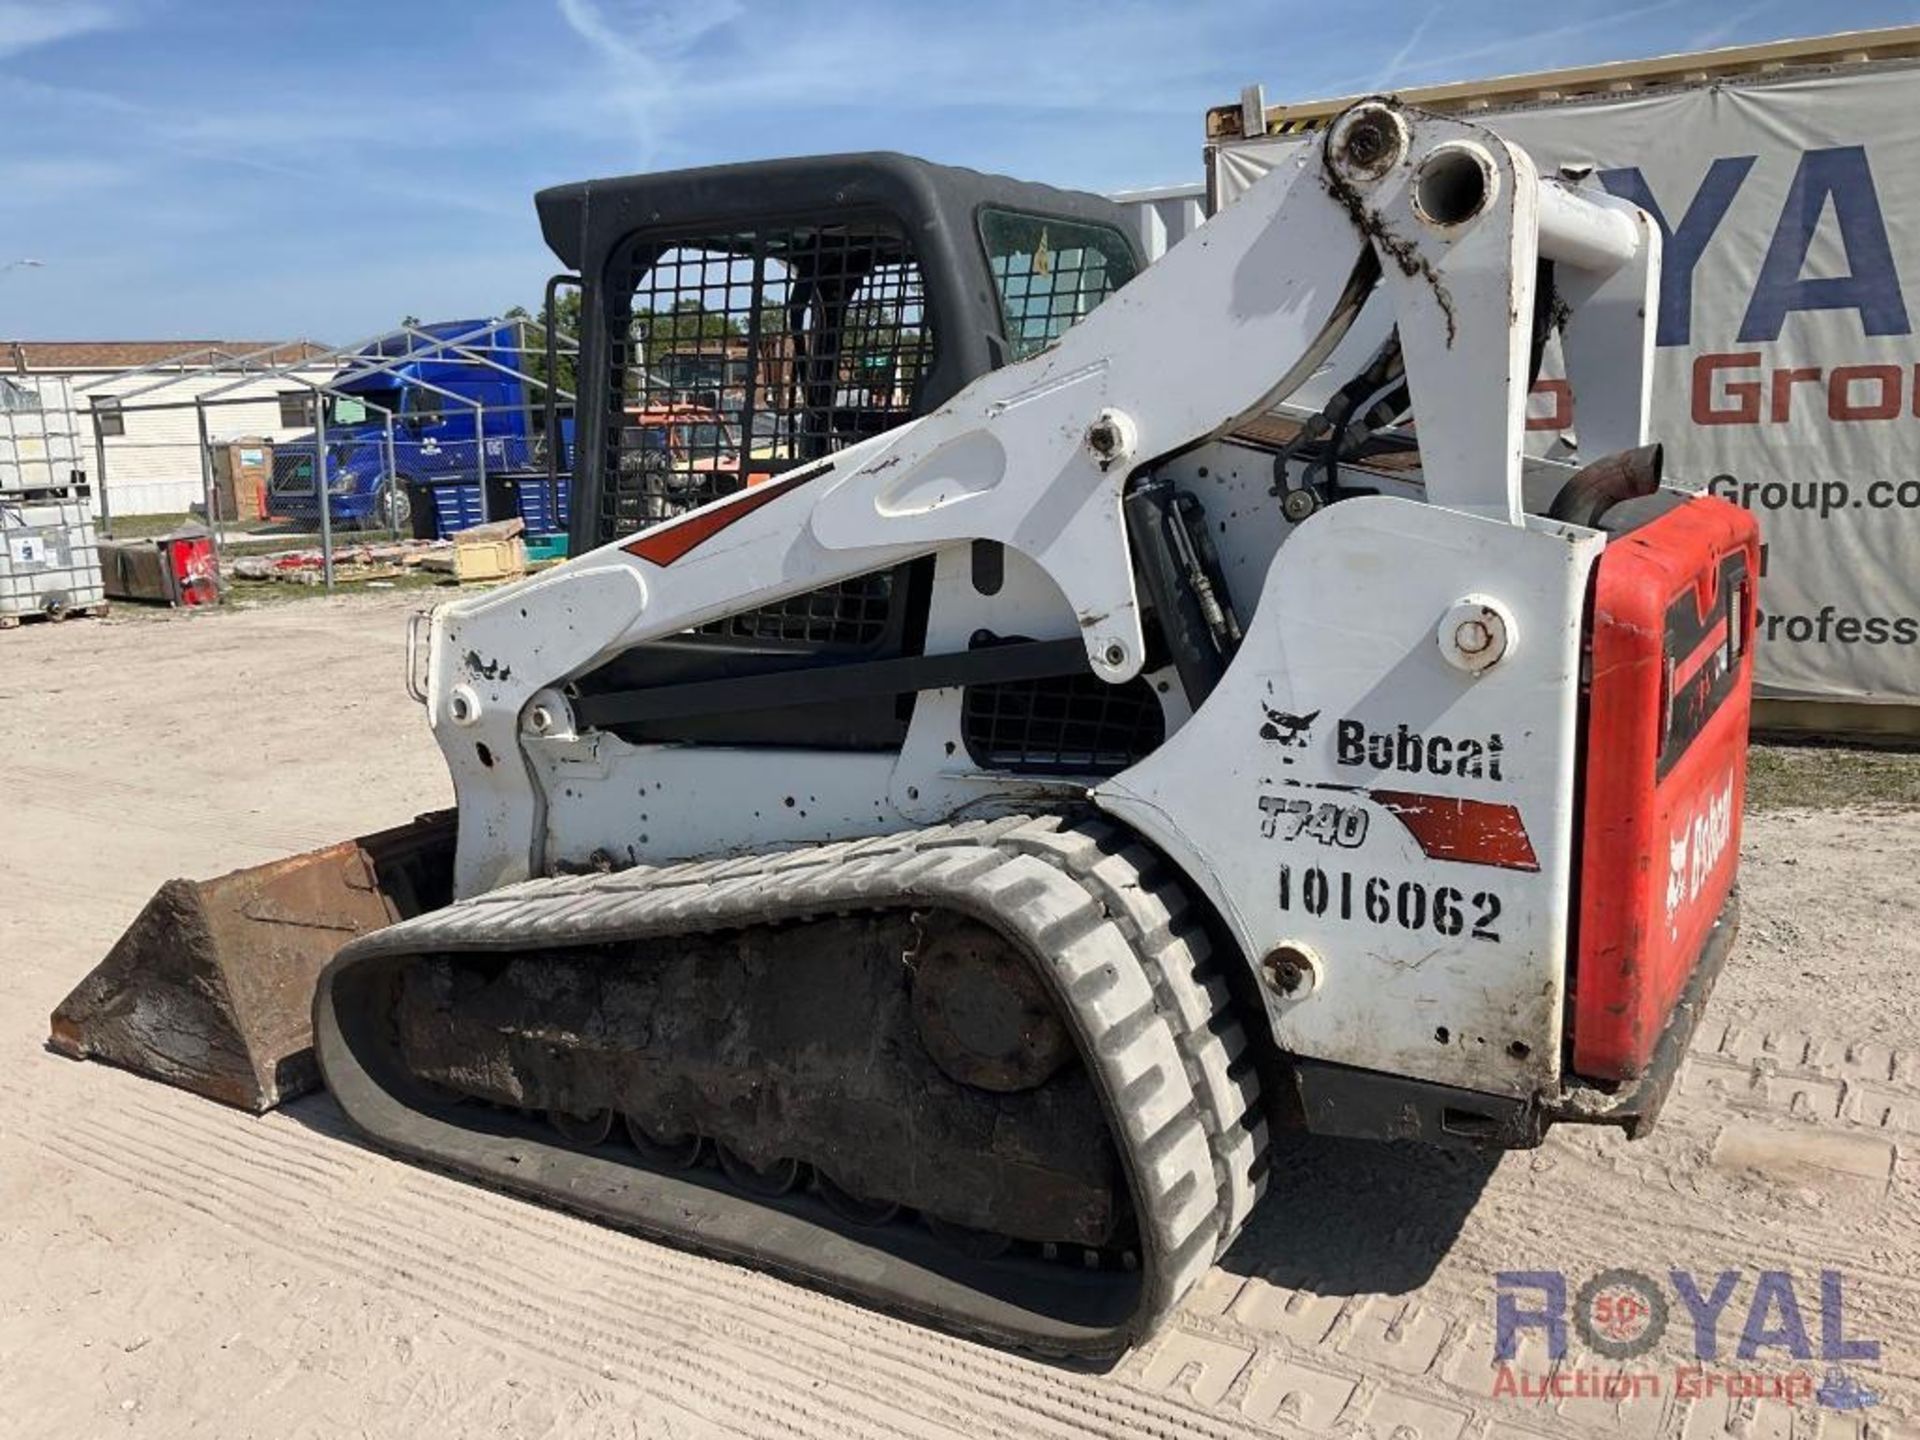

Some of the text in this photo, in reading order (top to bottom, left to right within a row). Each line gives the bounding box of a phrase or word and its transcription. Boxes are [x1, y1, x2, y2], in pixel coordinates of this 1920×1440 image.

[1691, 351, 1920, 426] Gro
[1337, 719, 1504, 782] Bobcat
[1258, 796, 1370, 849] T740
[1279, 863, 1502, 943] 1016062
